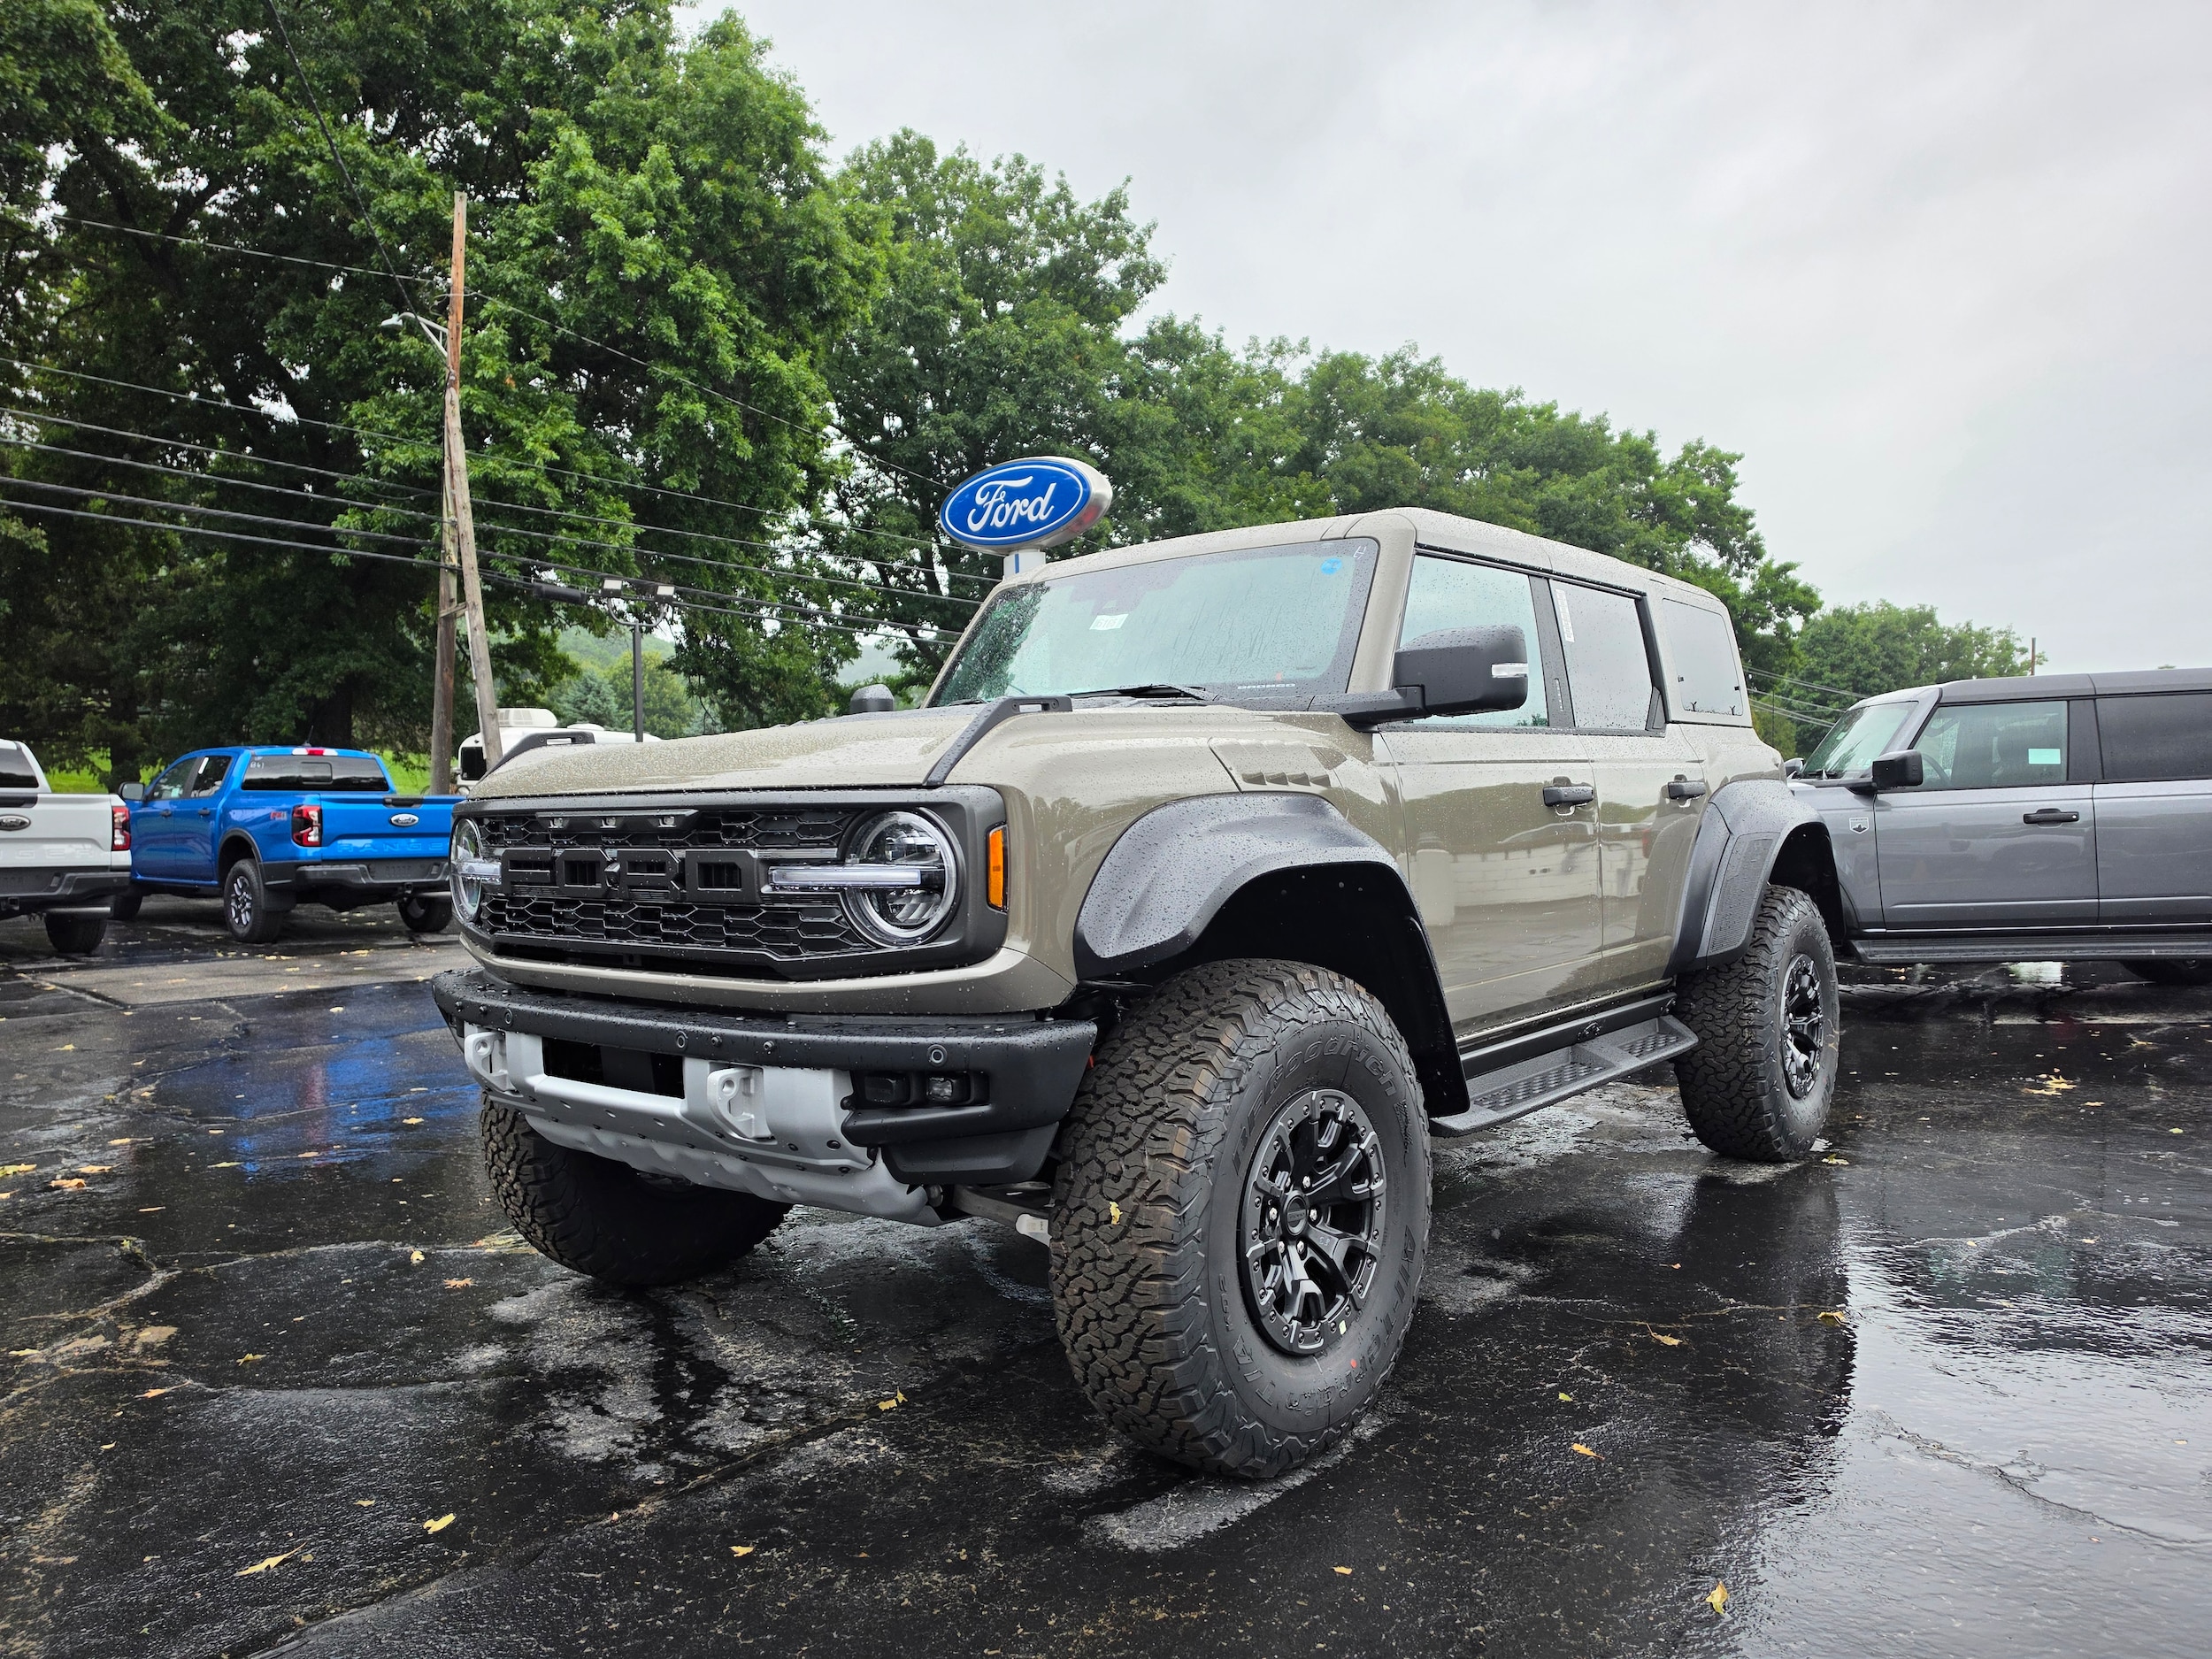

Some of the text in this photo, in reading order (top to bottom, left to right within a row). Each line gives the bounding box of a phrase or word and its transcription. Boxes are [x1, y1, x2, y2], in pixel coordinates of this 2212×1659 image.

[967, 475, 1057, 532] Ford
[0, 848, 94, 859] GER
[336, 842, 444, 853] RANGE
[501, 848, 759, 903] FORD
[1232, 1033, 1397, 1175] BFGoodrich
